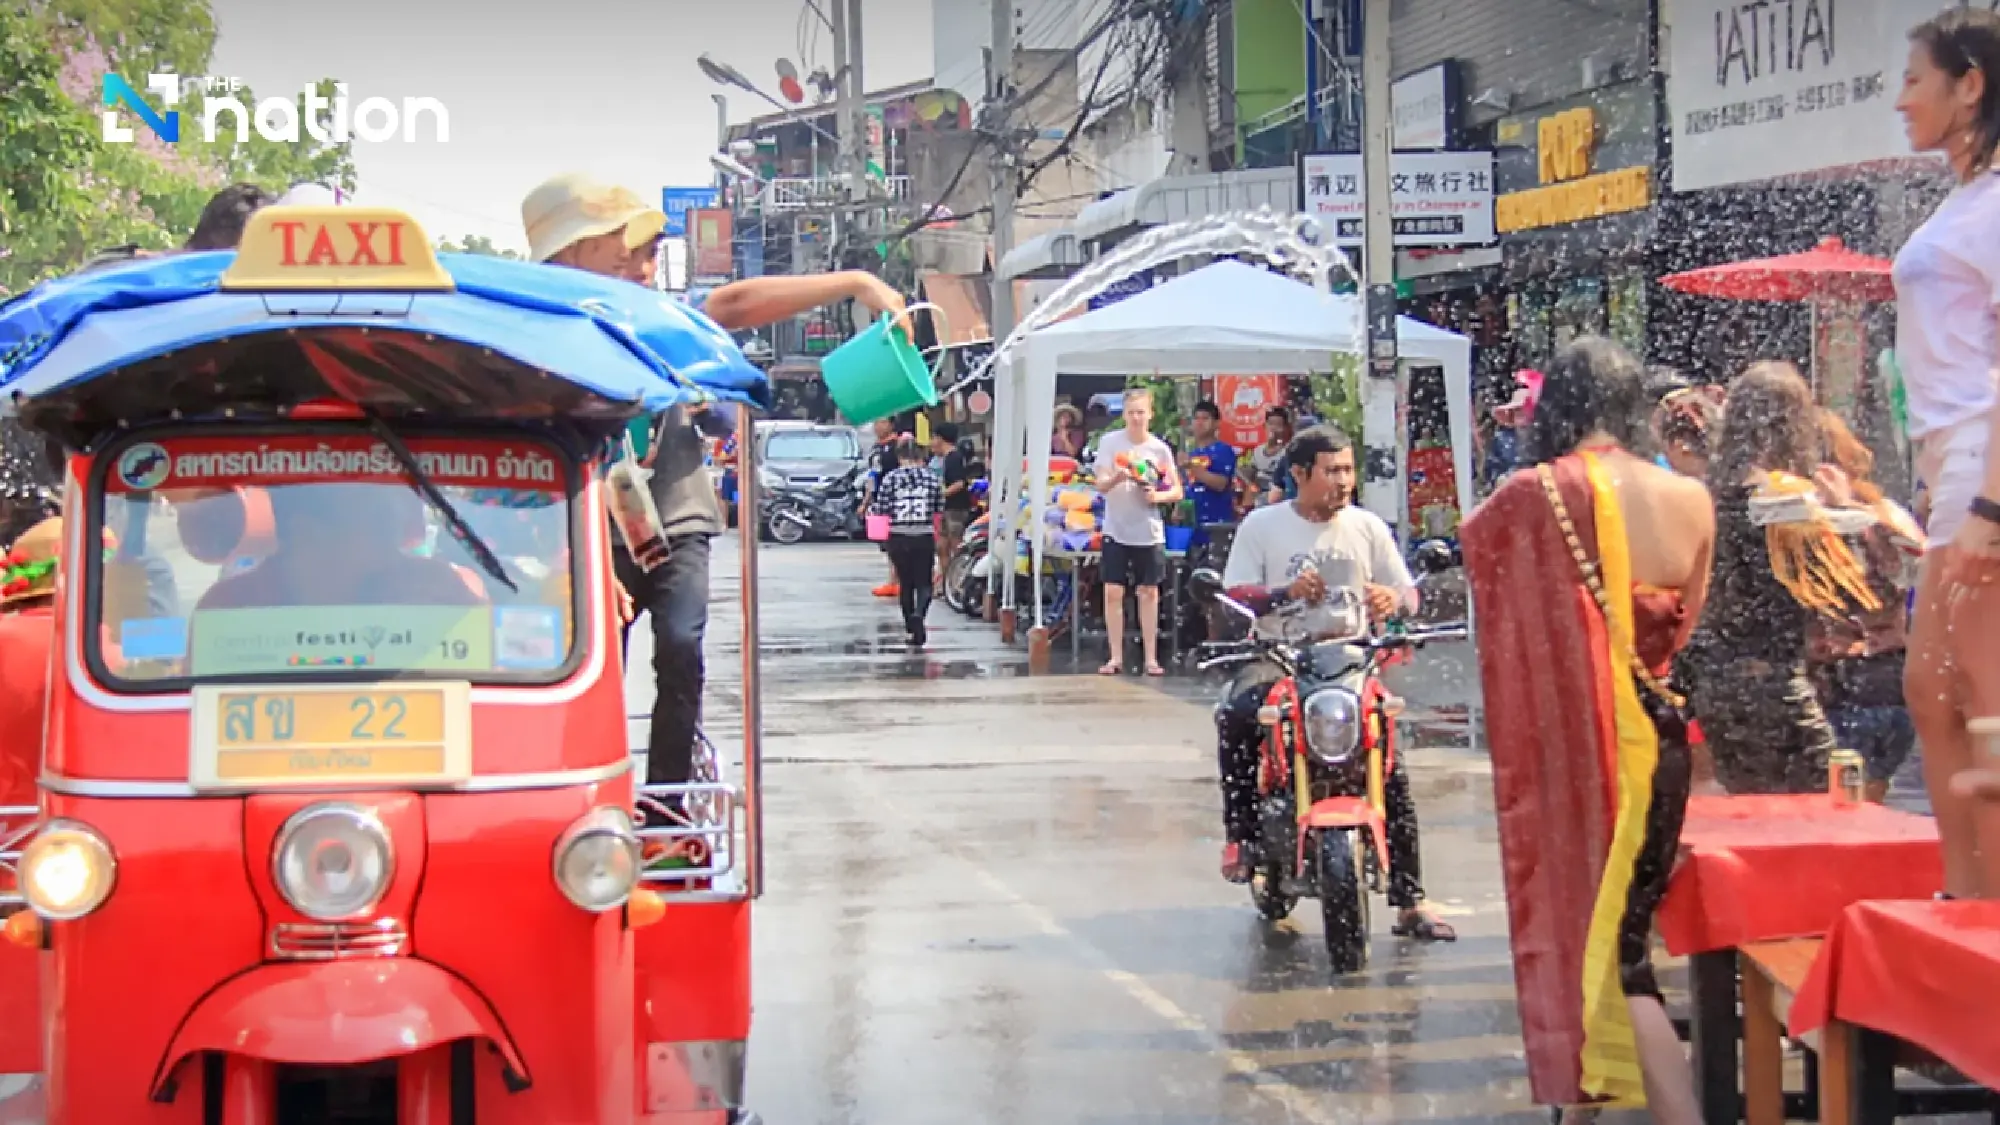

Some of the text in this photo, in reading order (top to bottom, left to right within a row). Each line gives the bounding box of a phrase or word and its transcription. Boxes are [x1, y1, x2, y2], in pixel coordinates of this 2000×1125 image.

[1308, 170, 1489, 196] 清迈文旅行社
[1317, 201, 1355, 213] Travel
[271, 222, 406, 266] TAXI
[893, 499, 927, 521] 23
[440, 639, 469, 659] 19
[350, 696, 407, 739] 22
